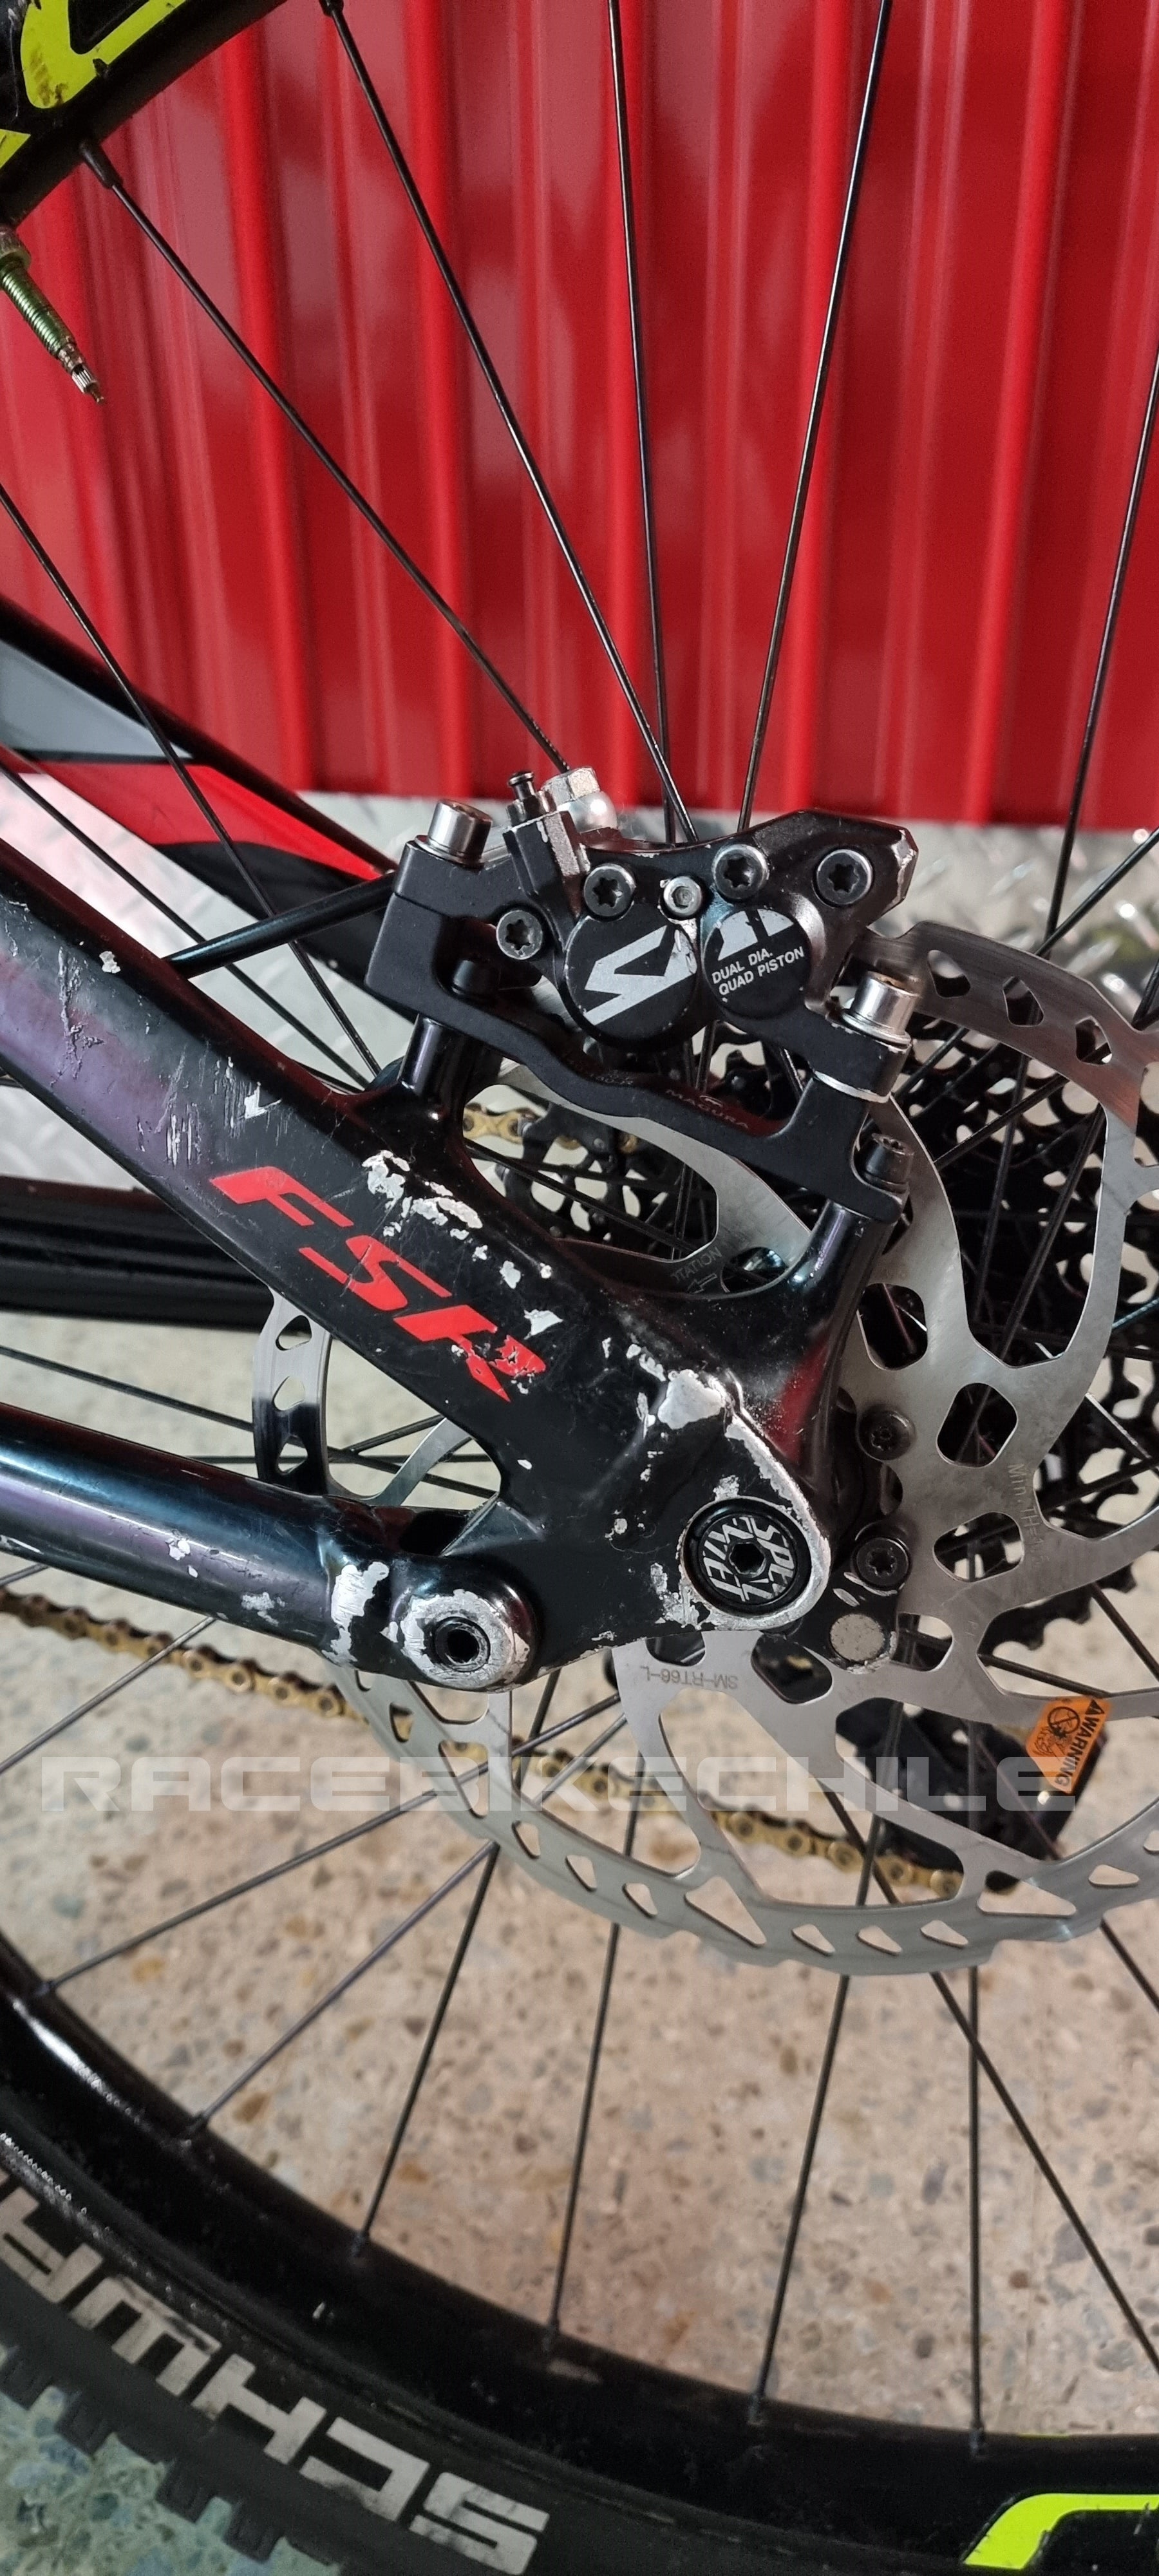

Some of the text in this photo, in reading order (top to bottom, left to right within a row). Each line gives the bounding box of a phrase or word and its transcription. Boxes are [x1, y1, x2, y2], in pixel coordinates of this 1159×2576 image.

[711, 949, 773, 984] DUAL DIA.
[719, 947, 805, 996] QUAD PISTON
[665, 1088, 748, 1129] MAGURA
[210, 1166, 547, 1402] FSR
[640, 1665, 739, 1689] SM-RT66-L
[1054, 1716, 1100, 1787] WARNING
[0, 2168, 549, 2575] SCHWA
